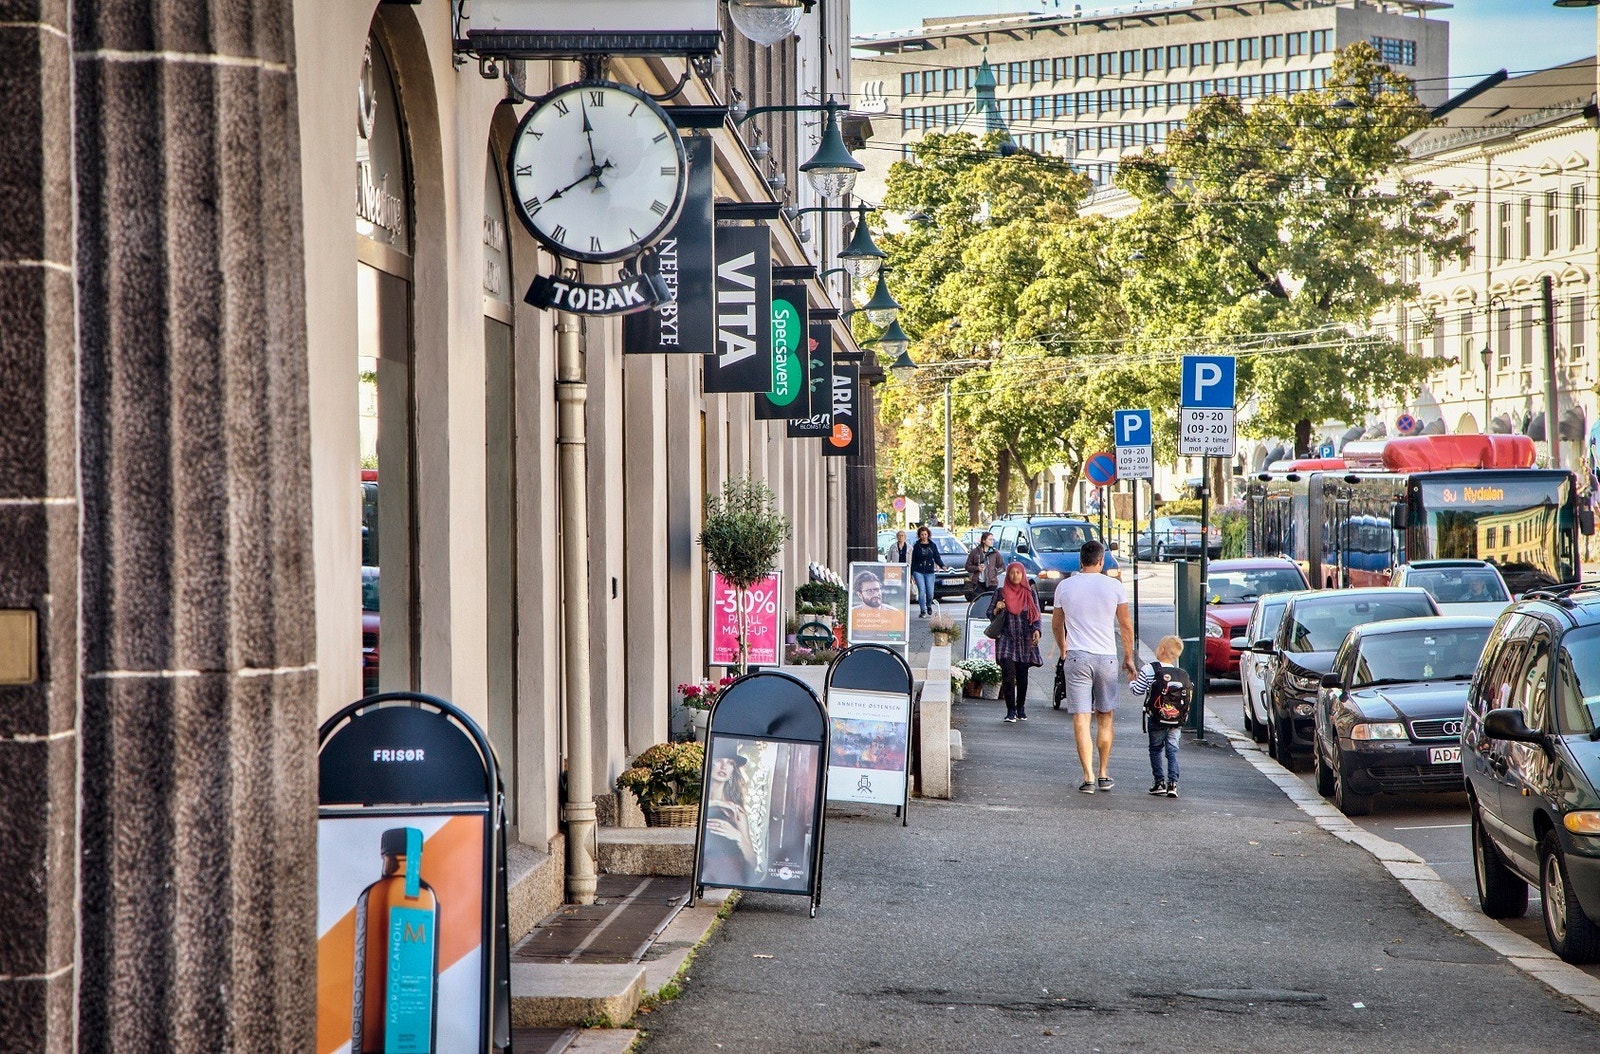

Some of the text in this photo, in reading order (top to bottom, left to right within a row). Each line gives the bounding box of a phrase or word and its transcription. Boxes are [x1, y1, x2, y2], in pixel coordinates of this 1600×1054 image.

[589, 91, 604, 107] XII
[552, 99, 570, 118] XI
[627, 102, 639, 117] I
[526, 126, 544, 141] X
[652, 132, 668, 144] II
[516, 164, 532, 177] IX
[660, 166, 676, 177] III
[523, 196, 543, 219] VIII
[550, 224, 567, 244] VII
[629, 227, 640, 243] V
[589, 236, 603, 252] VI
[552, 282, 645, 311] TOBAK
[718, 251, 756, 368] VITA
[772, 309, 790, 396] Specsavers
[1195, 362, 1223, 401] P
[833, 375, 852, 417] ARK
[1191, 412, 1224, 421] 09-20
[1124, 414, 1143, 442] P
[1187, 424, 1228, 435] (09-20)
[1122, 448, 1146, 456] 09-20
[1204, 445, 1225, 454] avgift
[1324, 447, 1331, 458] P
[1120, 456, 1149, 465] (09-20)
[1463, 486, 1504, 504] Nydalen
[715, 590, 776, 614] -30%
[868, 703, 901, 711] ØSTENSEN
[373, 749, 425, 762] FRISØR
[403, 921, 427, 944] M
[390, 918, 402, 1024] MOROCCANOIL
